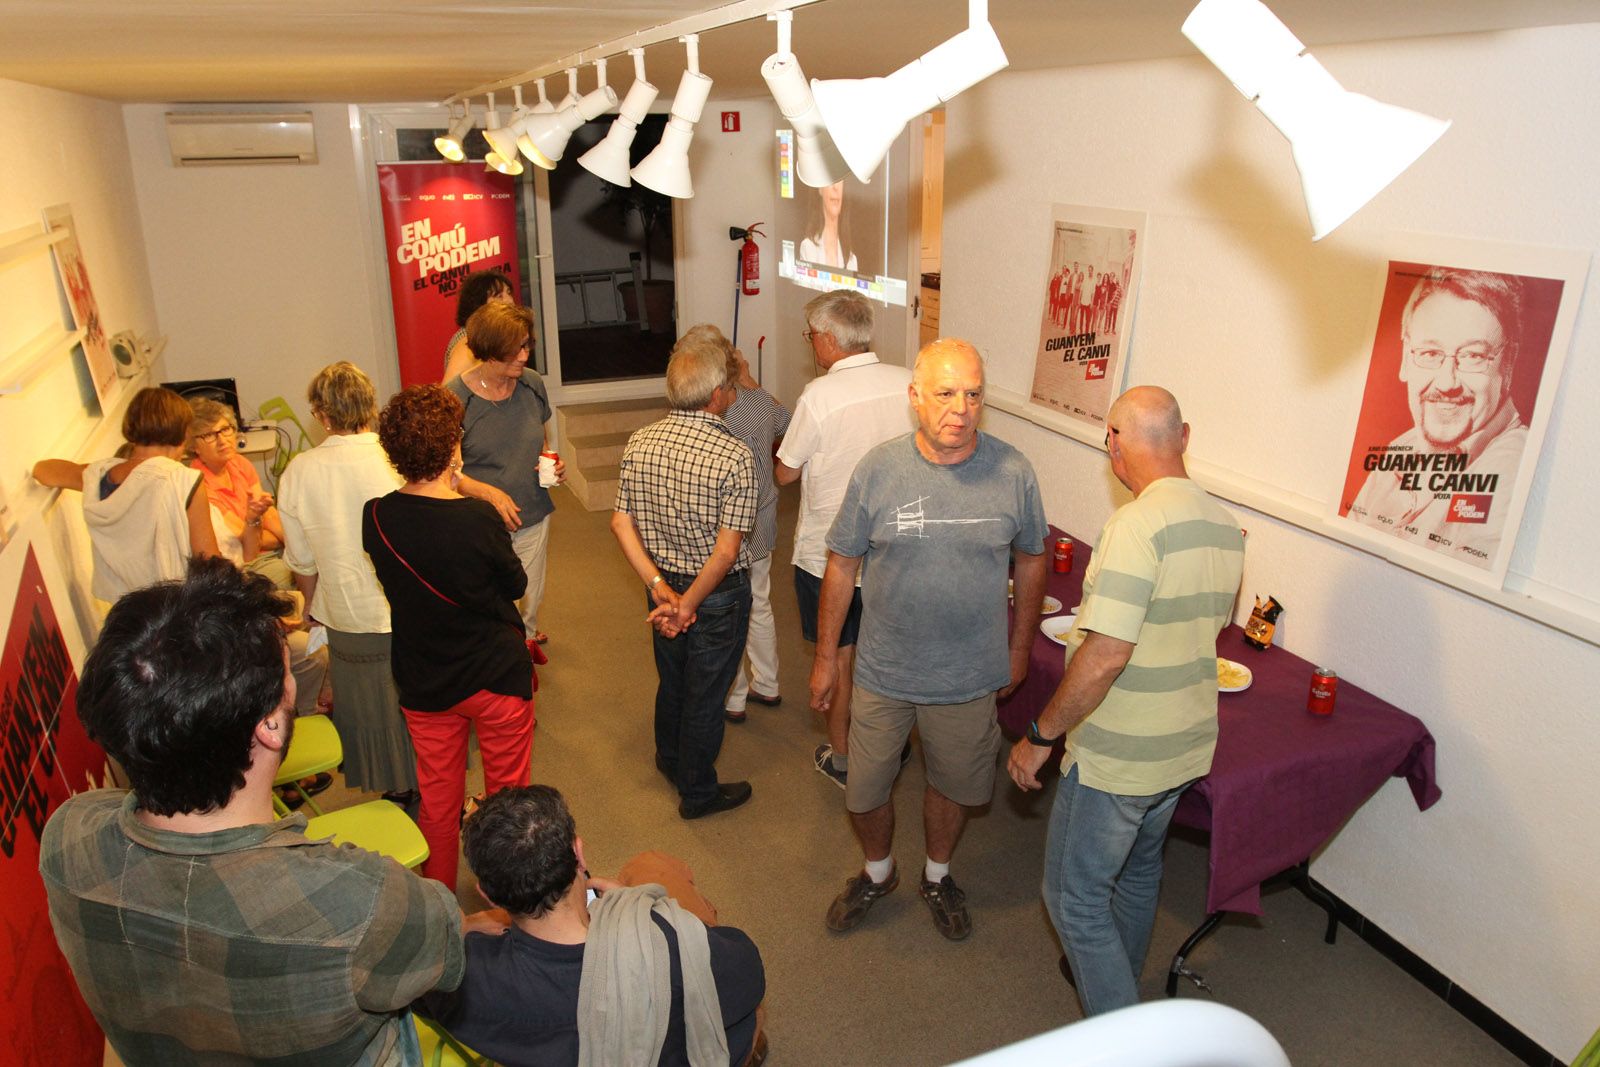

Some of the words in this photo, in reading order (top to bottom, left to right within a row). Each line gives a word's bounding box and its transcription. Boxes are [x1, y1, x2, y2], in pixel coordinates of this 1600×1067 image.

[401, 218, 431, 244] EN
[397, 222, 466, 264] COMÚ
[419, 236, 500, 278] PODEM
[413, 277, 428, 291] EL
[430, 264, 470, 284] CANVI
[438, 280, 457, 294] NO
[1045, 332, 1096, 352] GUANYEM
[1063, 349, 1075, 362] EL
[1077, 344, 1111, 361] CANVI
[1363, 453, 1468, 472] GUANYEM
[1400, 473, 1422, 491] EL
[1428, 473, 1499, 492] CANVI
